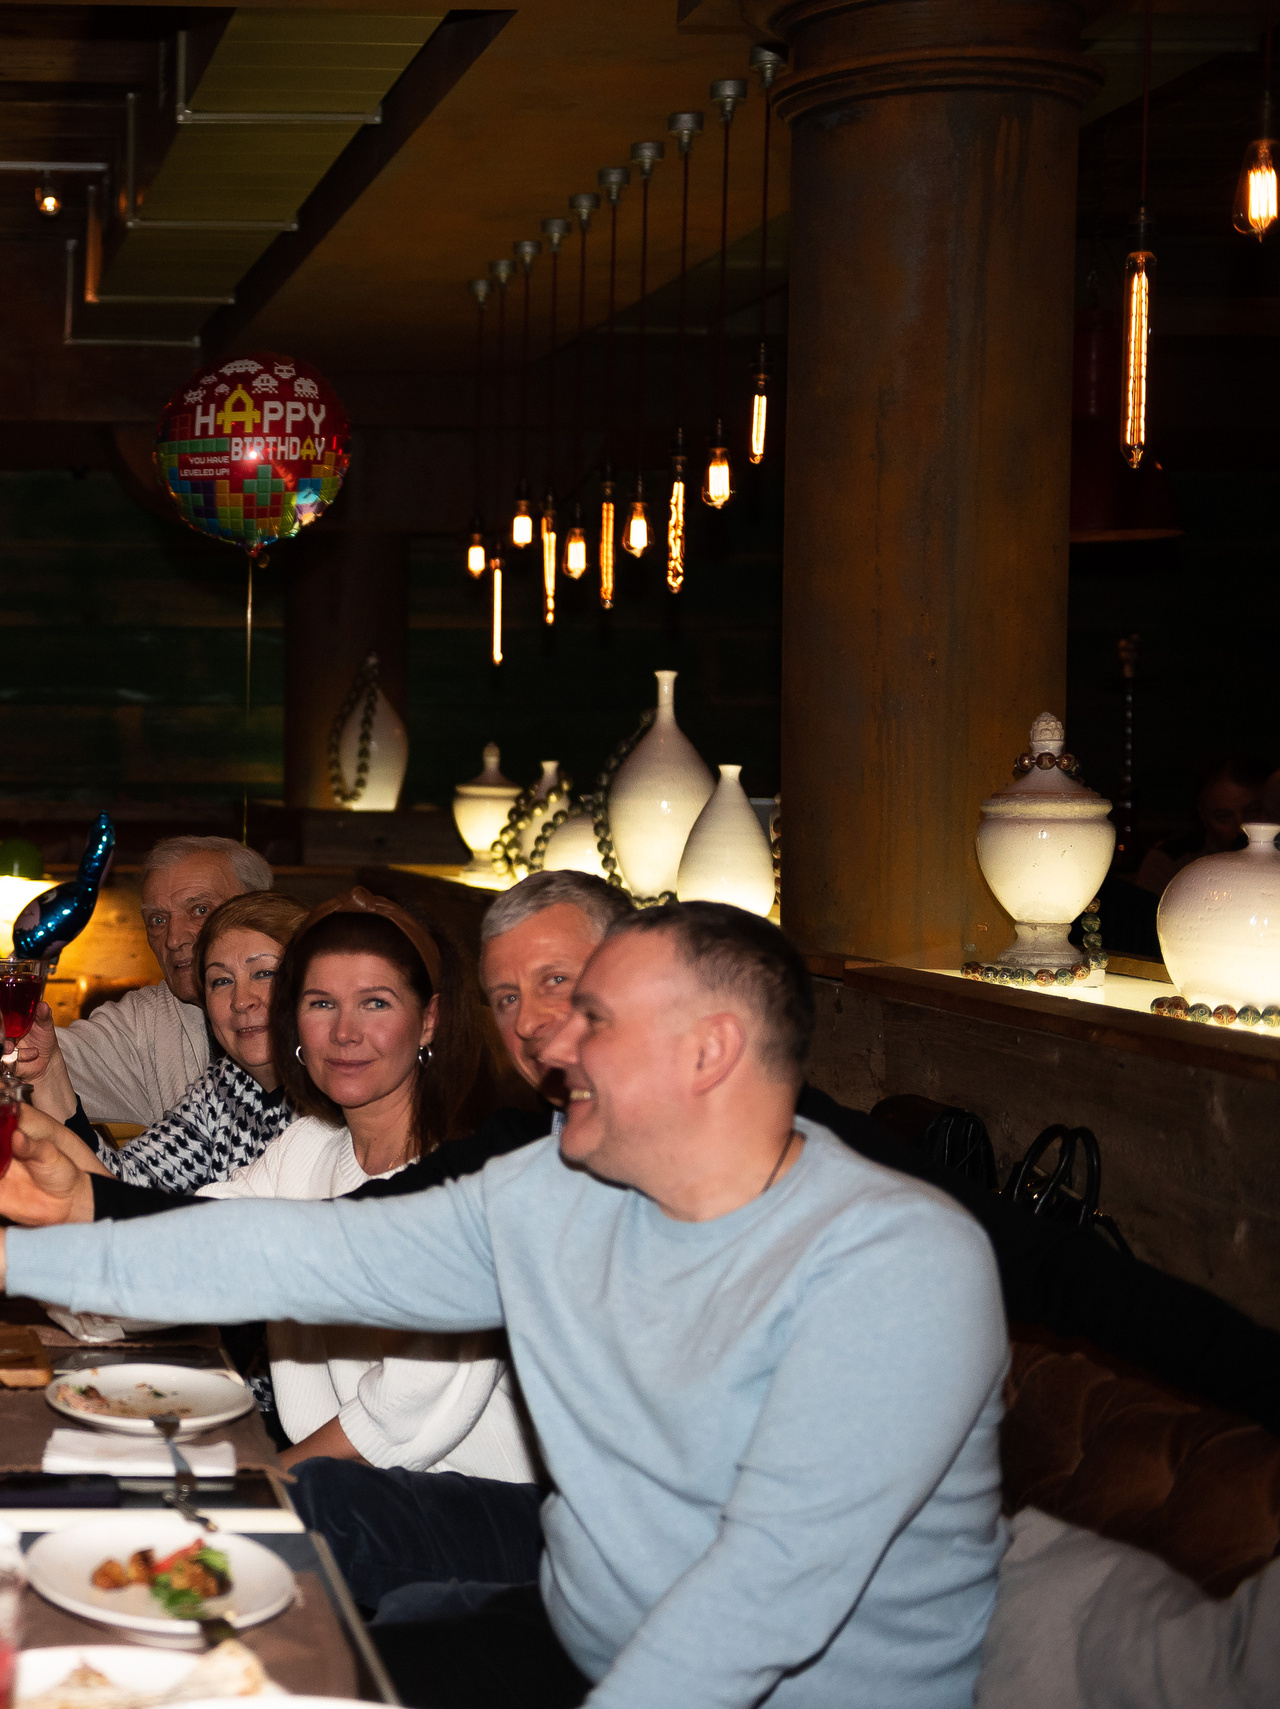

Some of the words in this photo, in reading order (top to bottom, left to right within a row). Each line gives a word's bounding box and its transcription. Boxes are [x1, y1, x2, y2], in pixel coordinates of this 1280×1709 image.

[195, 383, 326, 436] HAPPY
[231, 435, 326, 461] BIRTHDAY
[189, 456, 206, 465] YOU
[206, 455, 230, 464] HAVE
[180, 468, 215, 477] LEVELED
[215, 467, 230, 476] UP!
